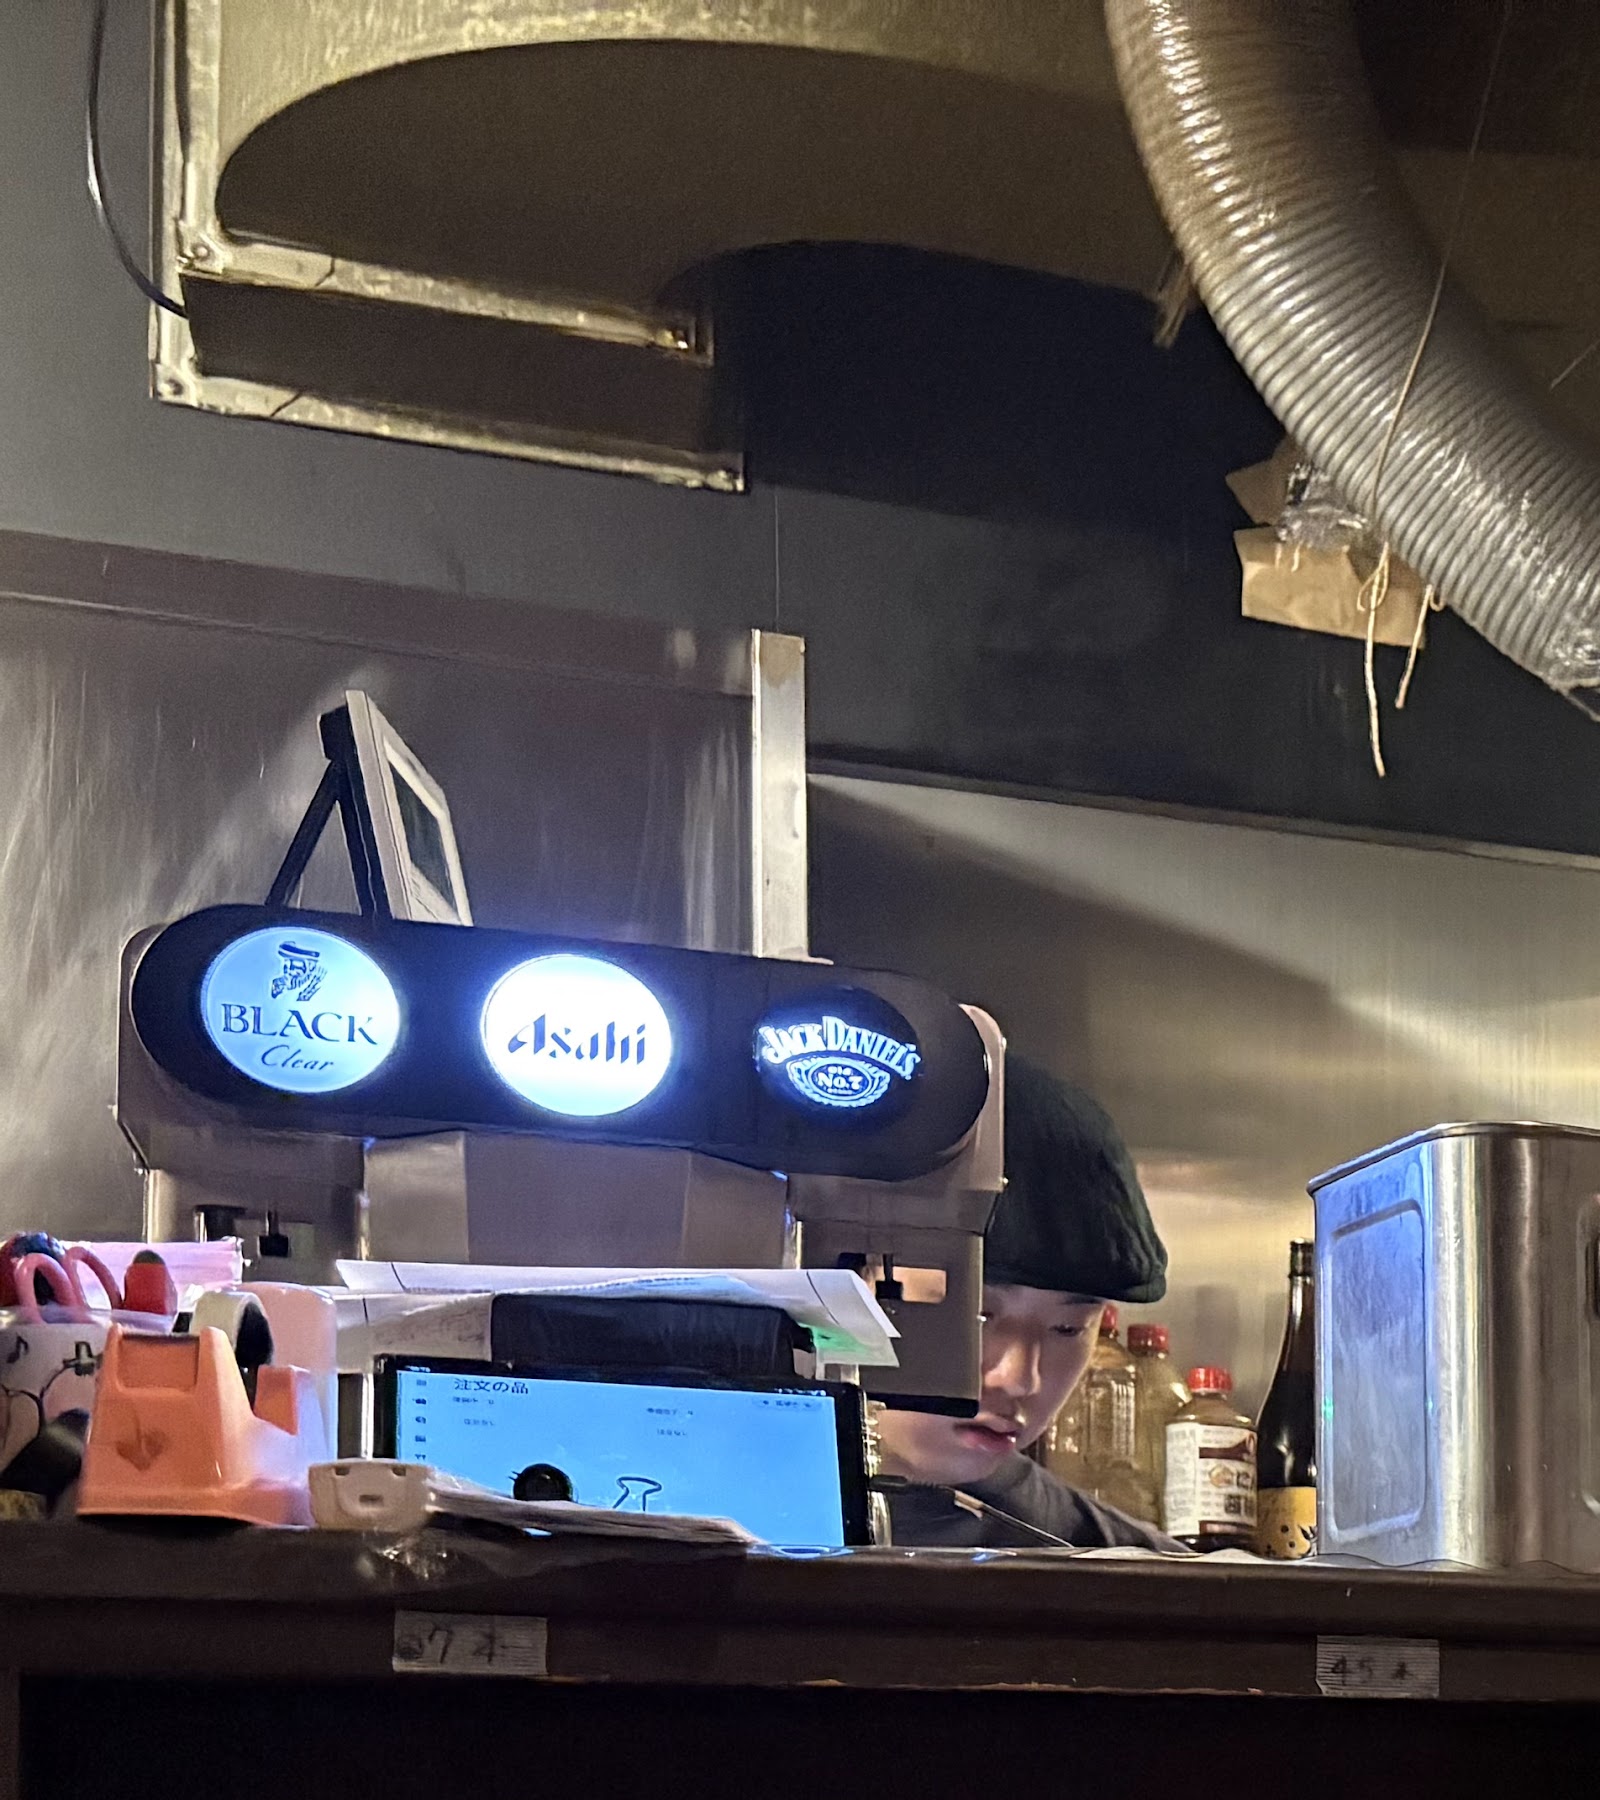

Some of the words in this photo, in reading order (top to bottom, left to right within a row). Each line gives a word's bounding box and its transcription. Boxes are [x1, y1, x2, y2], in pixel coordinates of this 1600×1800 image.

[222, 1003, 378, 1046] BLACK
[508, 1013, 646, 1065] Asahi
[261, 1045, 334, 1071] Clear
[759, 1022, 826, 1064] JACK
[822, 1015, 922, 1080] DANIEL'S
[454, 1378, 529, 1395] 注文の品
